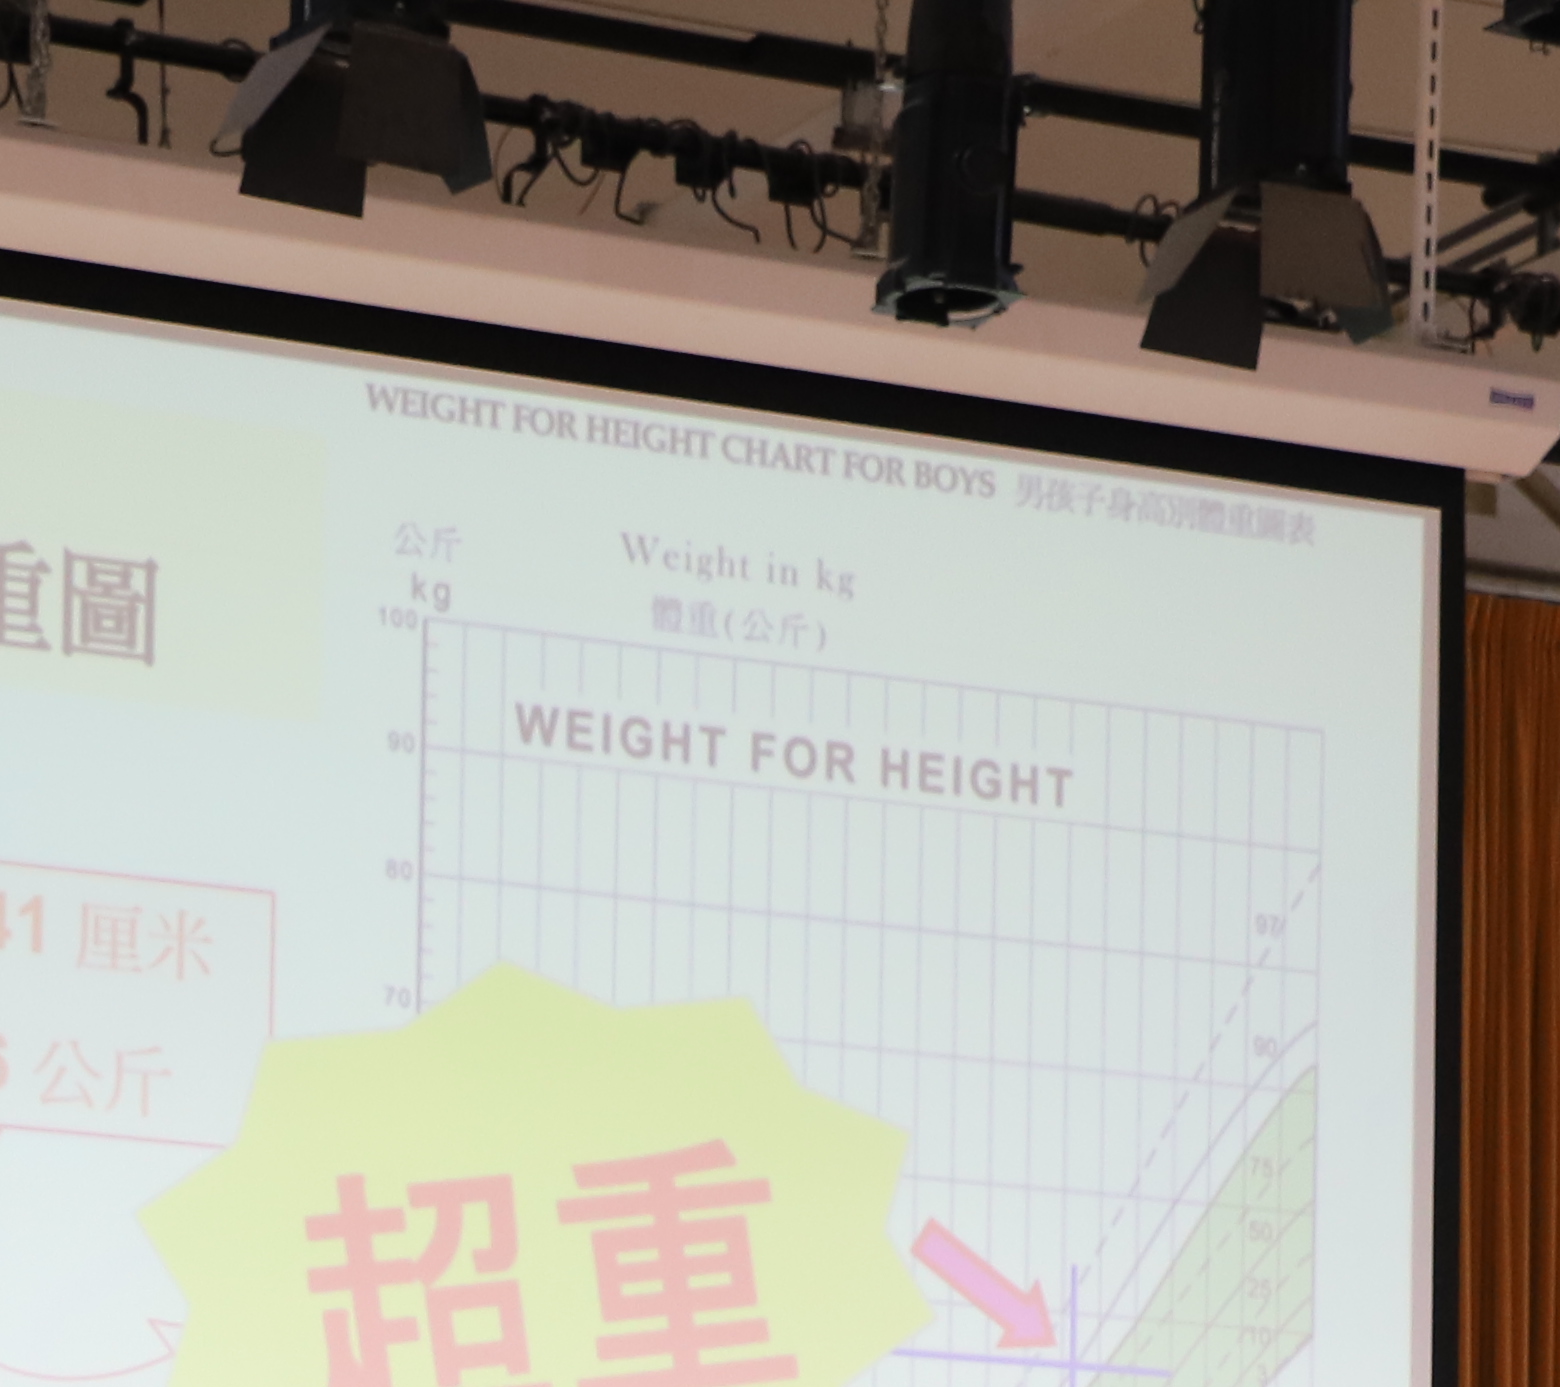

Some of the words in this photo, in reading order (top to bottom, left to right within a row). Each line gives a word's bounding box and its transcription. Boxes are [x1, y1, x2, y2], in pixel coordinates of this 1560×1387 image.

[366, 384, 504, 428] WEIGHT
[513, 404, 577, 440] FOR
[587, 415, 716, 460] HEIGHT
[720, 435, 833, 476] CHART
[843, 451, 906, 487] FOR
[914, 462, 996, 497] BOYS
[392, 522, 461, 563] 公斤
[620, 532, 751, 583] Weight
[766, 549, 799, 588] in
[816, 557, 857, 600] kg
[410, 572, 452, 612] kg
[378, 605, 418, 631] 100
[386, 731, 416, 756] 90
[515, 702, 726, 768] WEIGHT
[750, 731, 857, 784] FOR
[880, 747, 1074, 808] HEIGHT
[384, 856, 414, 884] 80
[77, 902, 213, 982] 厘米
[383, 983, 412, 1010] 70
[35, 1039, 171, 1117] 公斤
